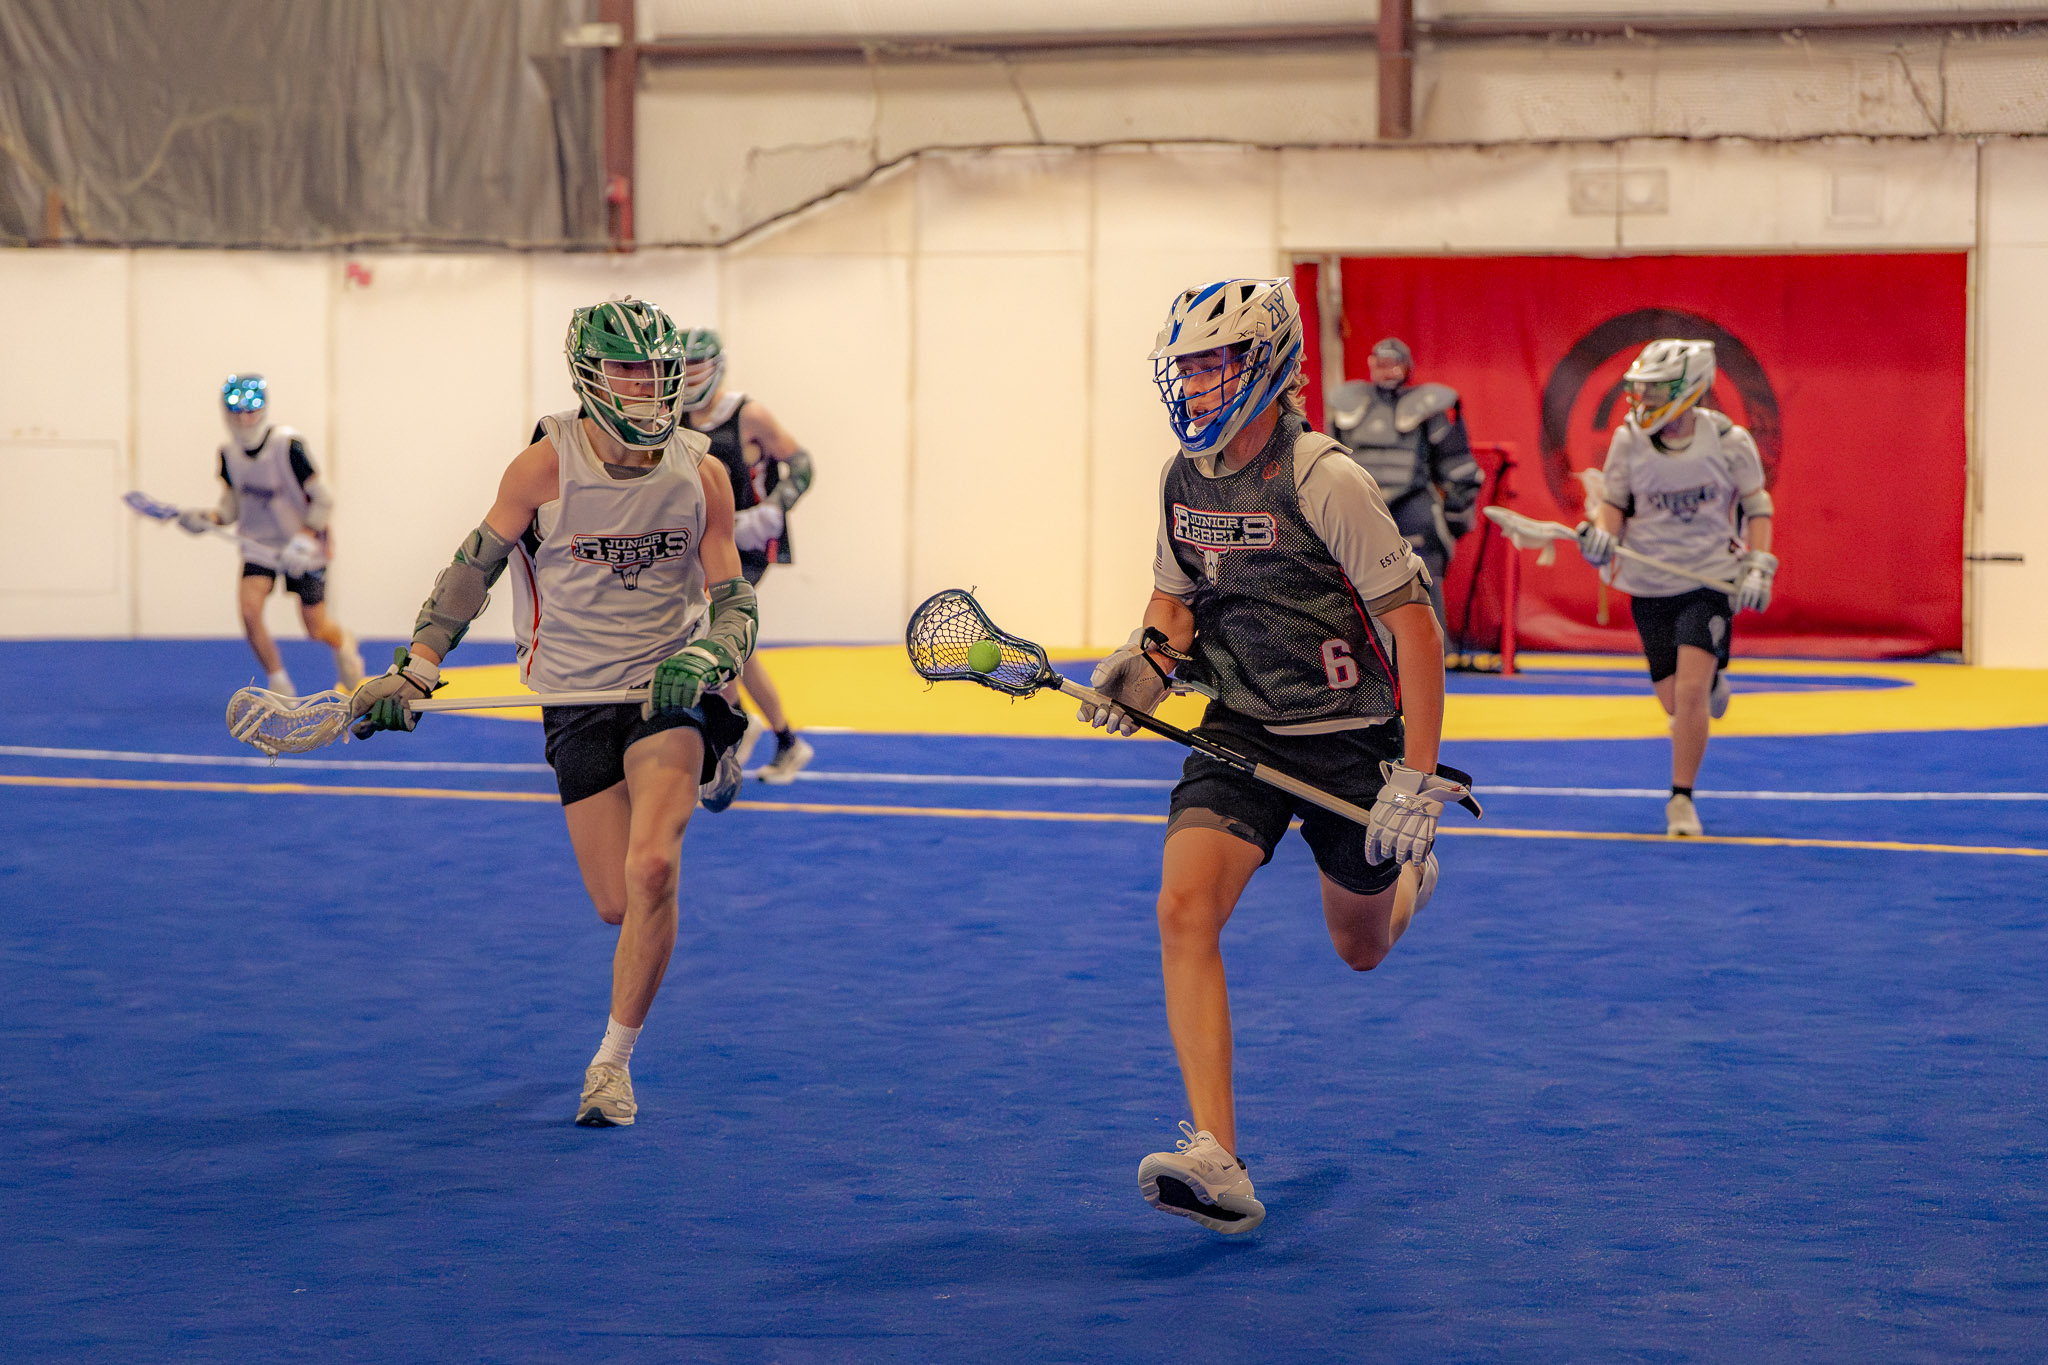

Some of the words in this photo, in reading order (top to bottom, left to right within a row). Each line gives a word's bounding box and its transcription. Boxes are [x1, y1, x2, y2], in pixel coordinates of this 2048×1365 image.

[1175, 507, 1274, 545] REBELS
[1189, 514, 1241, 530] JUNIOR
[575, 531, 687, 563] REBELS
[605, 533, 662, 550] JUNIOR
[1379, 551, 1400, 569] EST.
[1320, 638, 1359, 690] 6
